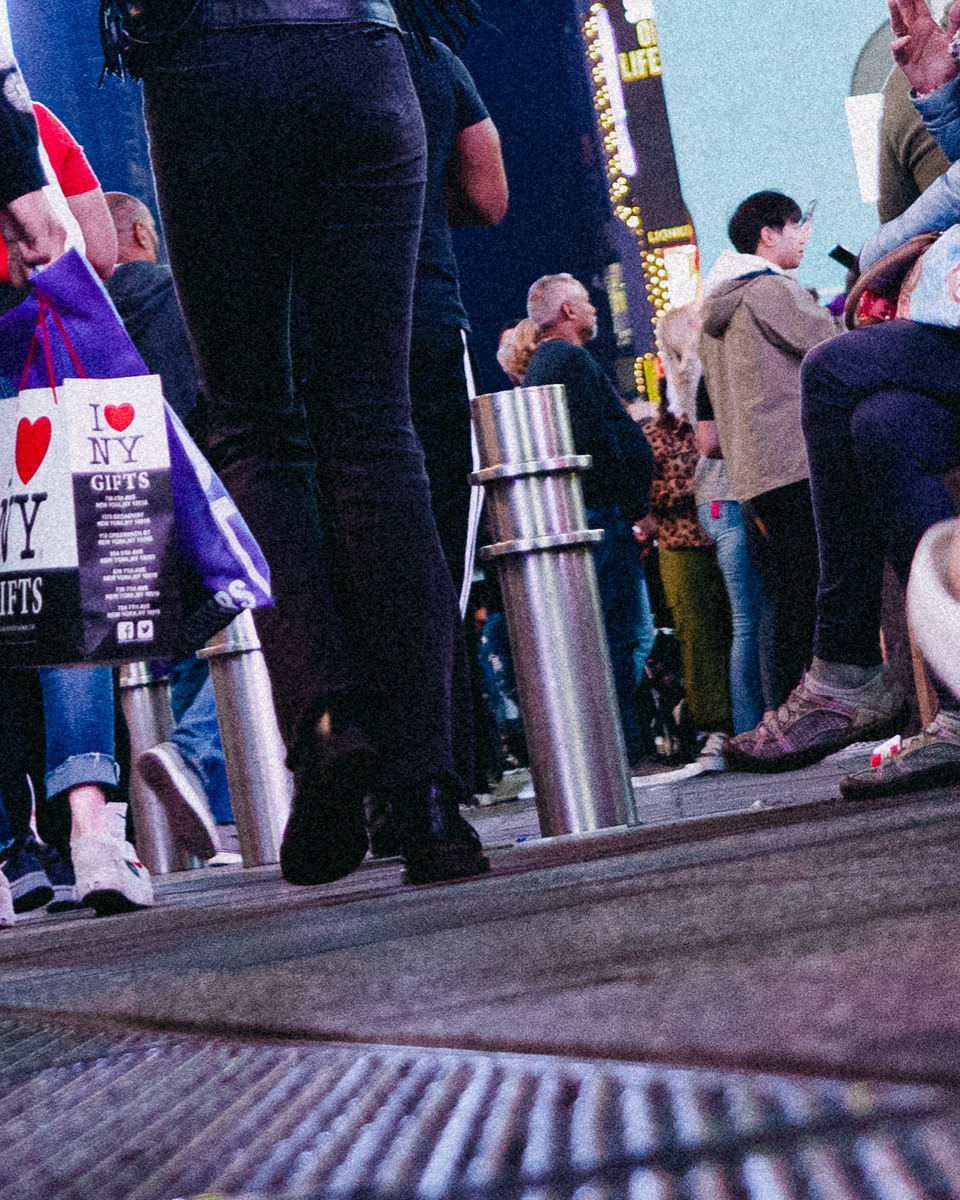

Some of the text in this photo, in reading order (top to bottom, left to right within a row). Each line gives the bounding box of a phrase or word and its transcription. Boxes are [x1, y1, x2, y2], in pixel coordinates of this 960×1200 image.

[618, 46, 663, 83] LIFE
[89, 403, 103, 432] I
[87, 434, 144, 466] NY
[91, 471, 151, 492] GIFTS
